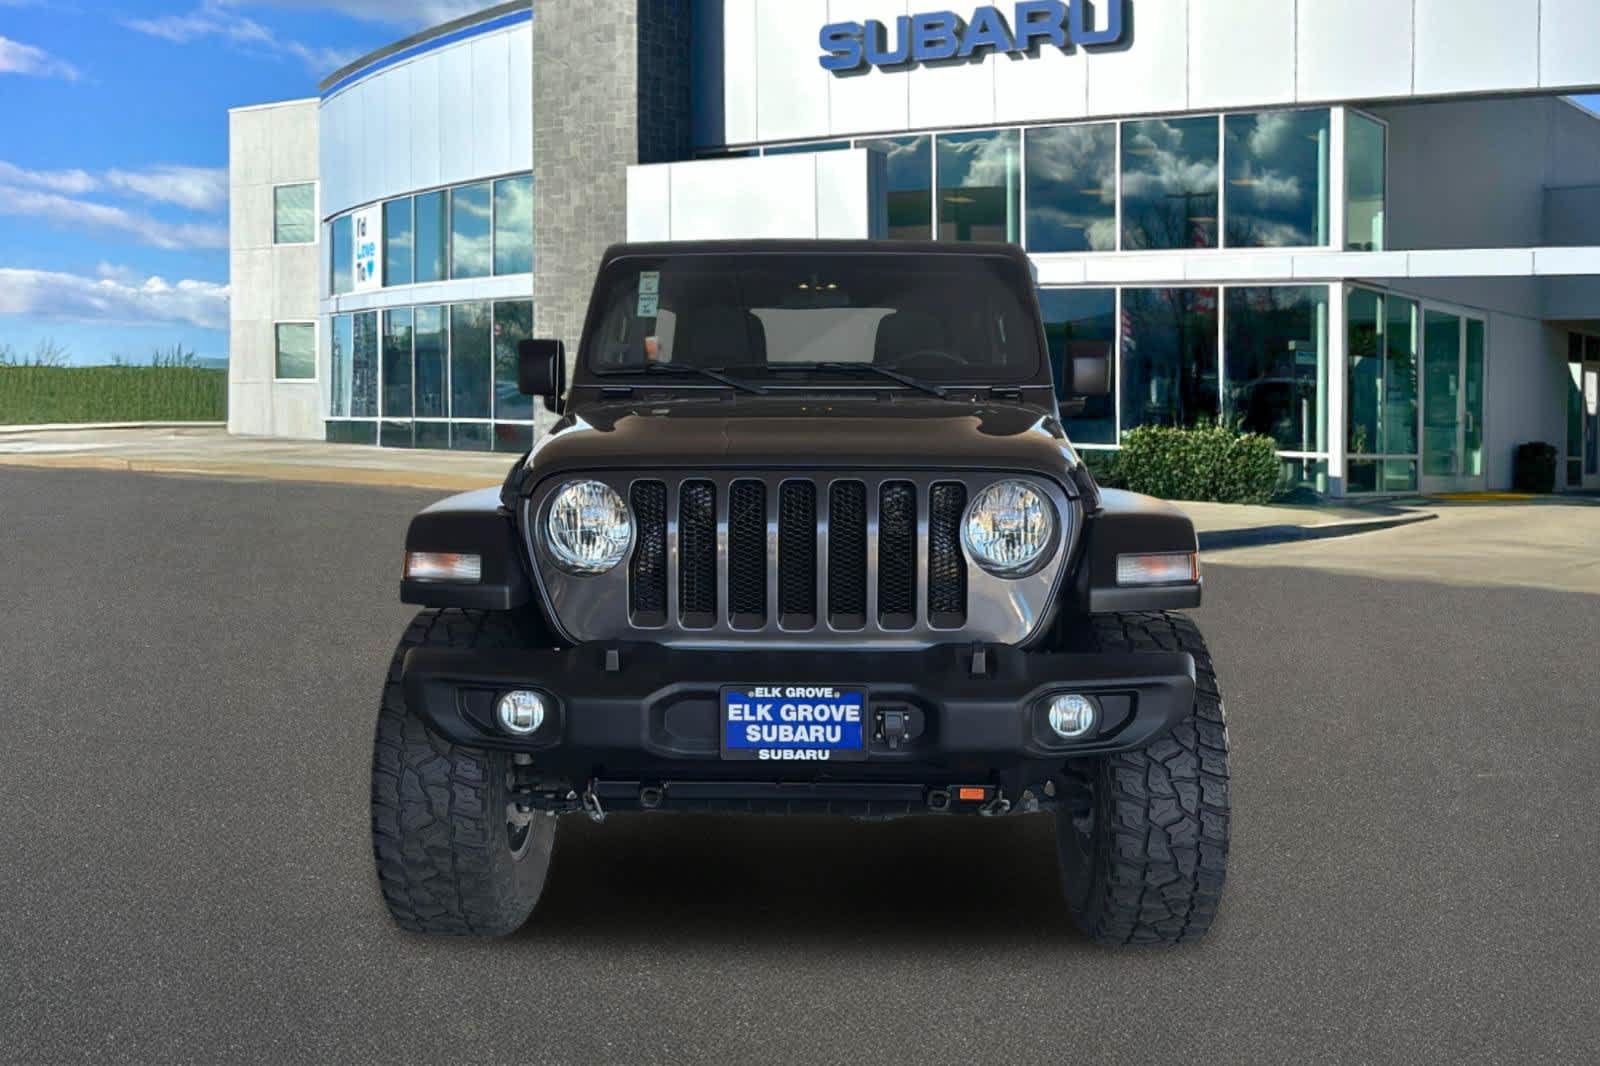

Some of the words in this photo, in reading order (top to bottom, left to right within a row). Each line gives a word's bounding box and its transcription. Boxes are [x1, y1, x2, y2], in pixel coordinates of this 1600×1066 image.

[819, 0, 1131, 75] SUBARU
[754, 687, 781, 698] ELK
[785, 687, 833, 698] GROVE
[727, 703, 773, 721] ELK
[779, 703, 860, 722] GROVE
[745, 724, 841, 742] SUBARU
[758, 748, 830, 760] SUBARU
